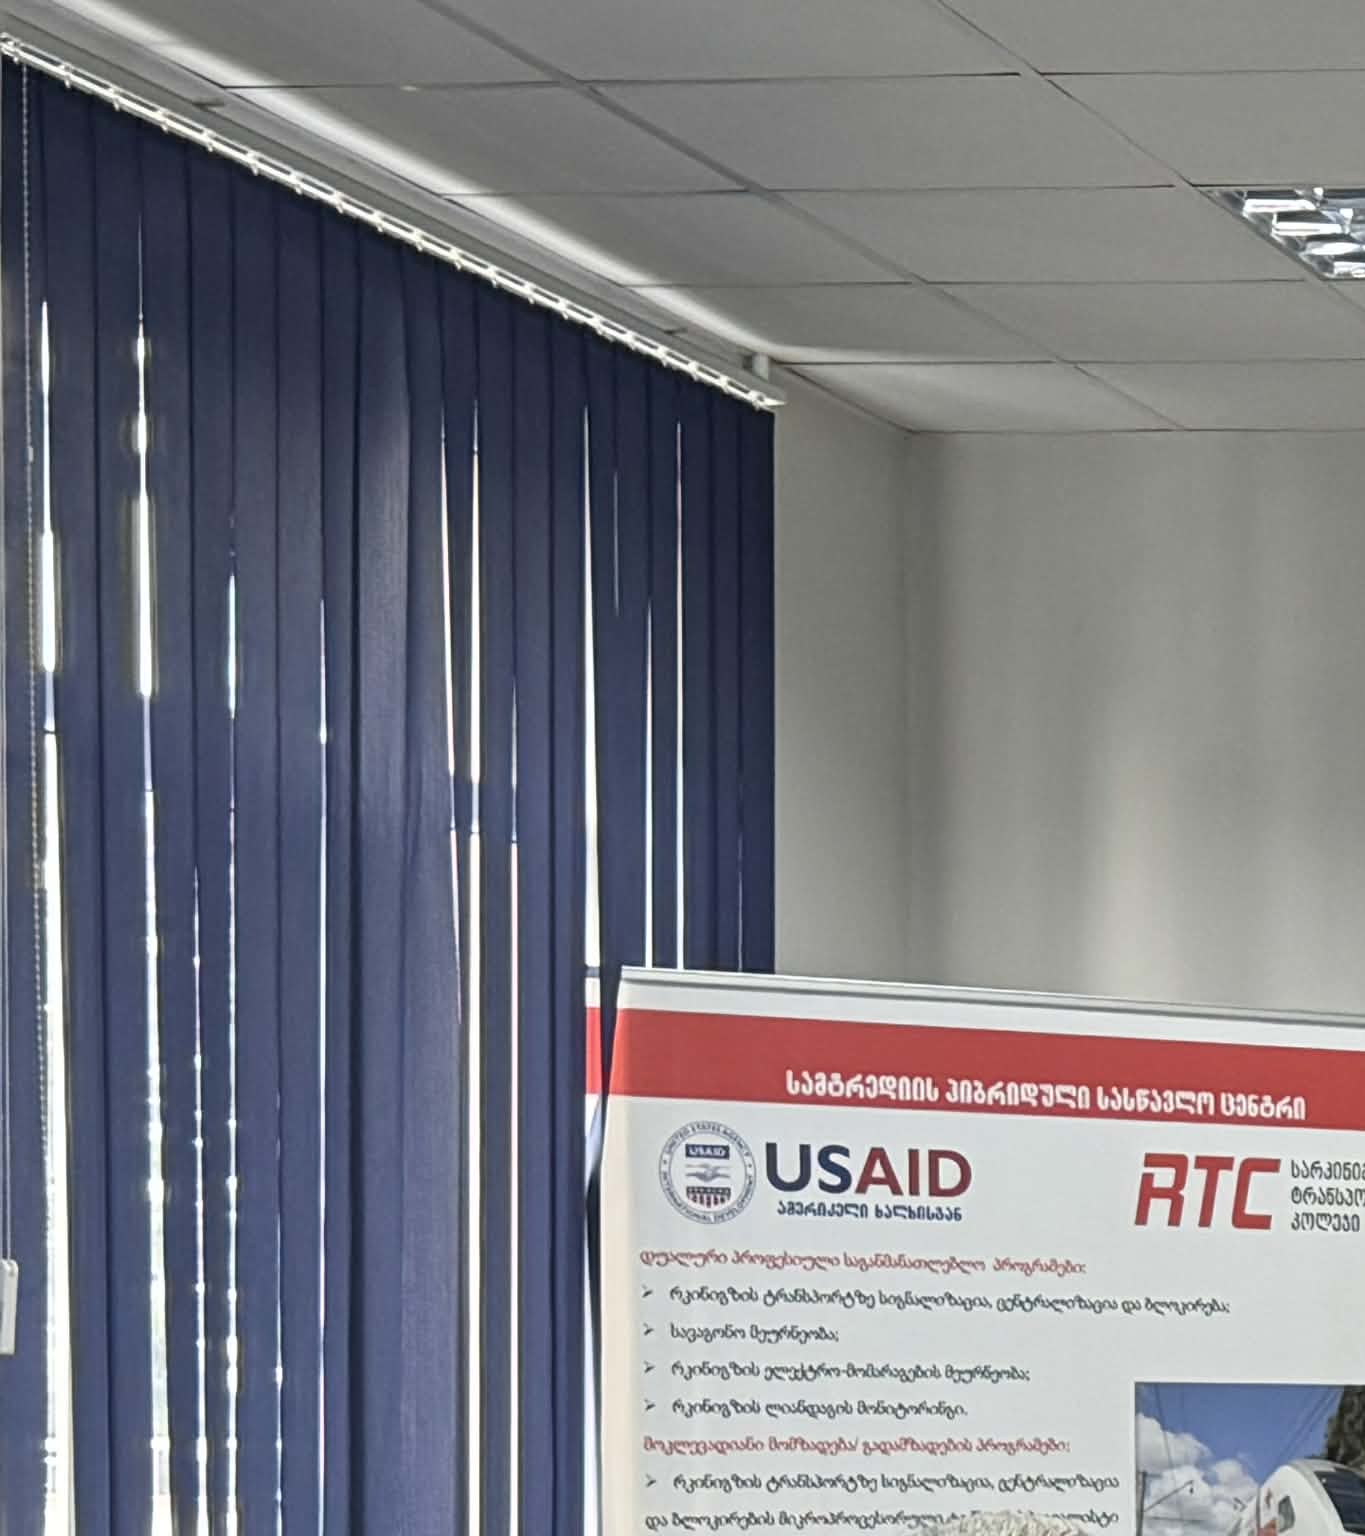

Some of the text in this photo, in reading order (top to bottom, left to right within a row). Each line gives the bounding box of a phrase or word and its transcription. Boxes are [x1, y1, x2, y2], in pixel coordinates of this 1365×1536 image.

[785, 1069, 1306, 1120] სამტრედიის ჰიბრიდული სასწავლო ცენტრი
[765, 1142, 972, 1198] USAID
[1134, 1152, 1281, 1231] RTC
[777, 1200, 962, 1222] ამერიკელი ხალხისგან
[1290, 1211, 1361, 1233] კოლეჯი
[640, 1249, 727, 1268] დუალური
[731, 1249, 840, 1271] პროფესიული
[670, 1286, 759, 1306] რკინიგზის
[763, 1288, 875, 1309] ტრანსპორტზე
[996, 1293, 1118, 1315] ცენტრალიზაცია
[1121, 1299, 1142, 1315] და
[670, 1322, 746, 1343] სავაგონო
[671, 1360, 760, 1381] რკინიგზის
[672, 1398, 968, 1420] რკინიგზის ლიანდაგის მონიტორინგი.
[643, 1435, 764, 1456] მოკლევადიანი
[862, 1436, 972, 1456] გადამზადების
[673, 1473, 762, 1493] რკინიგზის
[766, 1473, 878, 1493] ტრანსპორტზე
[998, 1473, 1120, 1493] ცენტრალიზაცია
[645, 1513, 668, 1531] და
[671, 1511, 775, 1531] ბლოკირების
